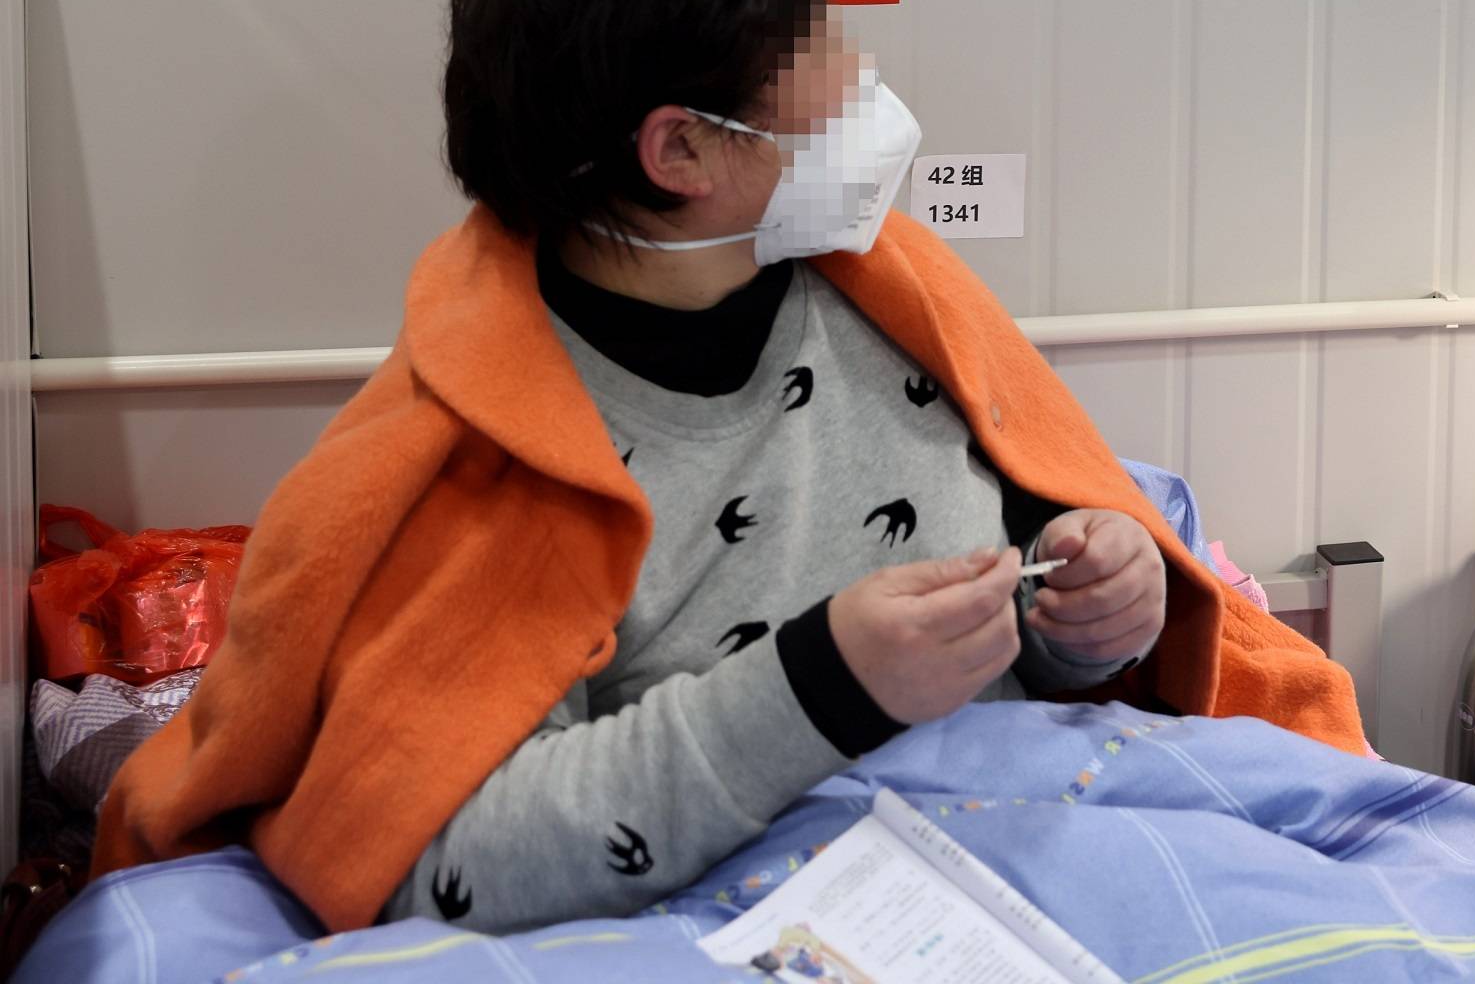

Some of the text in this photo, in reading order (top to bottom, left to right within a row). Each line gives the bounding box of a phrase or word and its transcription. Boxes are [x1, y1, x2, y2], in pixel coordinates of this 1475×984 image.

[928, 165, 983, 185] 42 组
[928, 204, 979, 223] 1341
